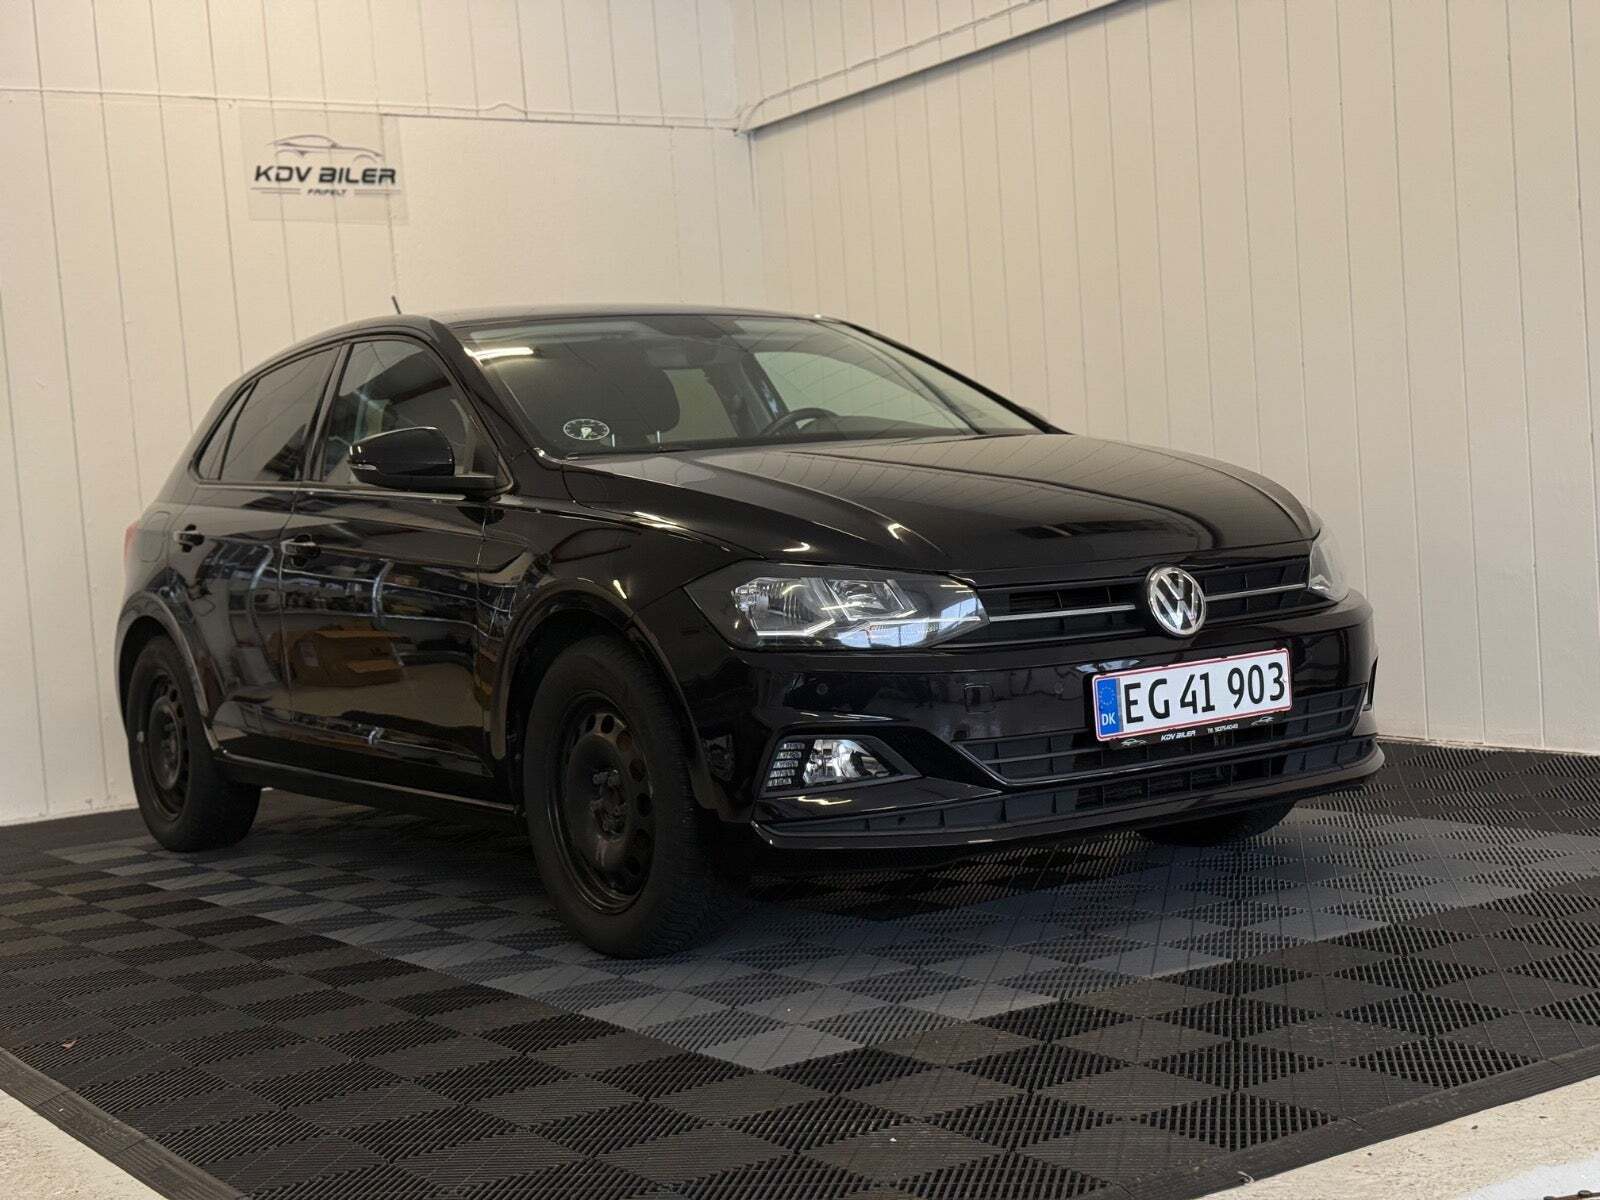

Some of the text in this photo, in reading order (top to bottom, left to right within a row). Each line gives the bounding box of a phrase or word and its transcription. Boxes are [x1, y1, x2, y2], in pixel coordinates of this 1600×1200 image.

[254, 165, 396, 184] KDV BILER
[1124, 661, 1286, 724] EG 41 903
[1101, 711, 1116, 726] DK
